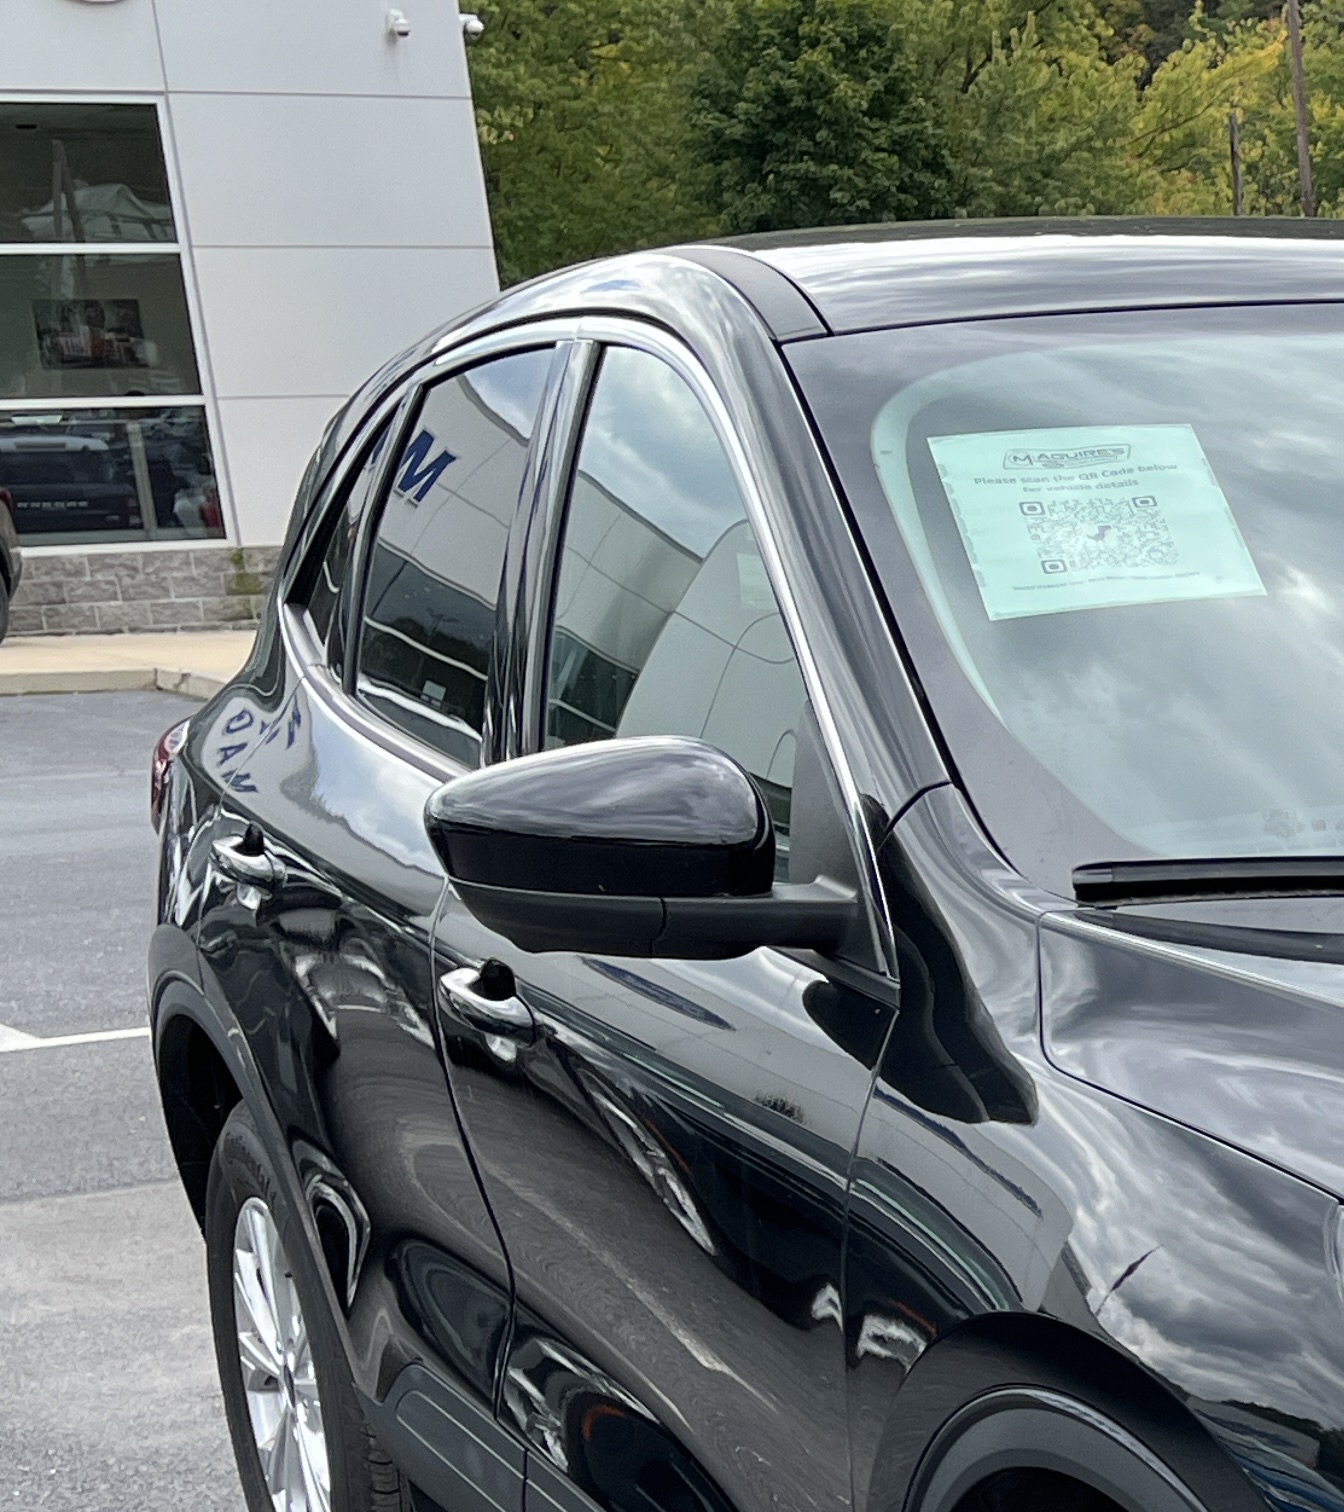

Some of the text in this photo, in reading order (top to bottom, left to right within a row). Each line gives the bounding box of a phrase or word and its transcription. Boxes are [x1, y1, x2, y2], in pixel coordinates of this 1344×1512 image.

[974, 462, 1178, 485] Please scan the QR Code below
[1022, 478, 1140, 494] for vehicle details
